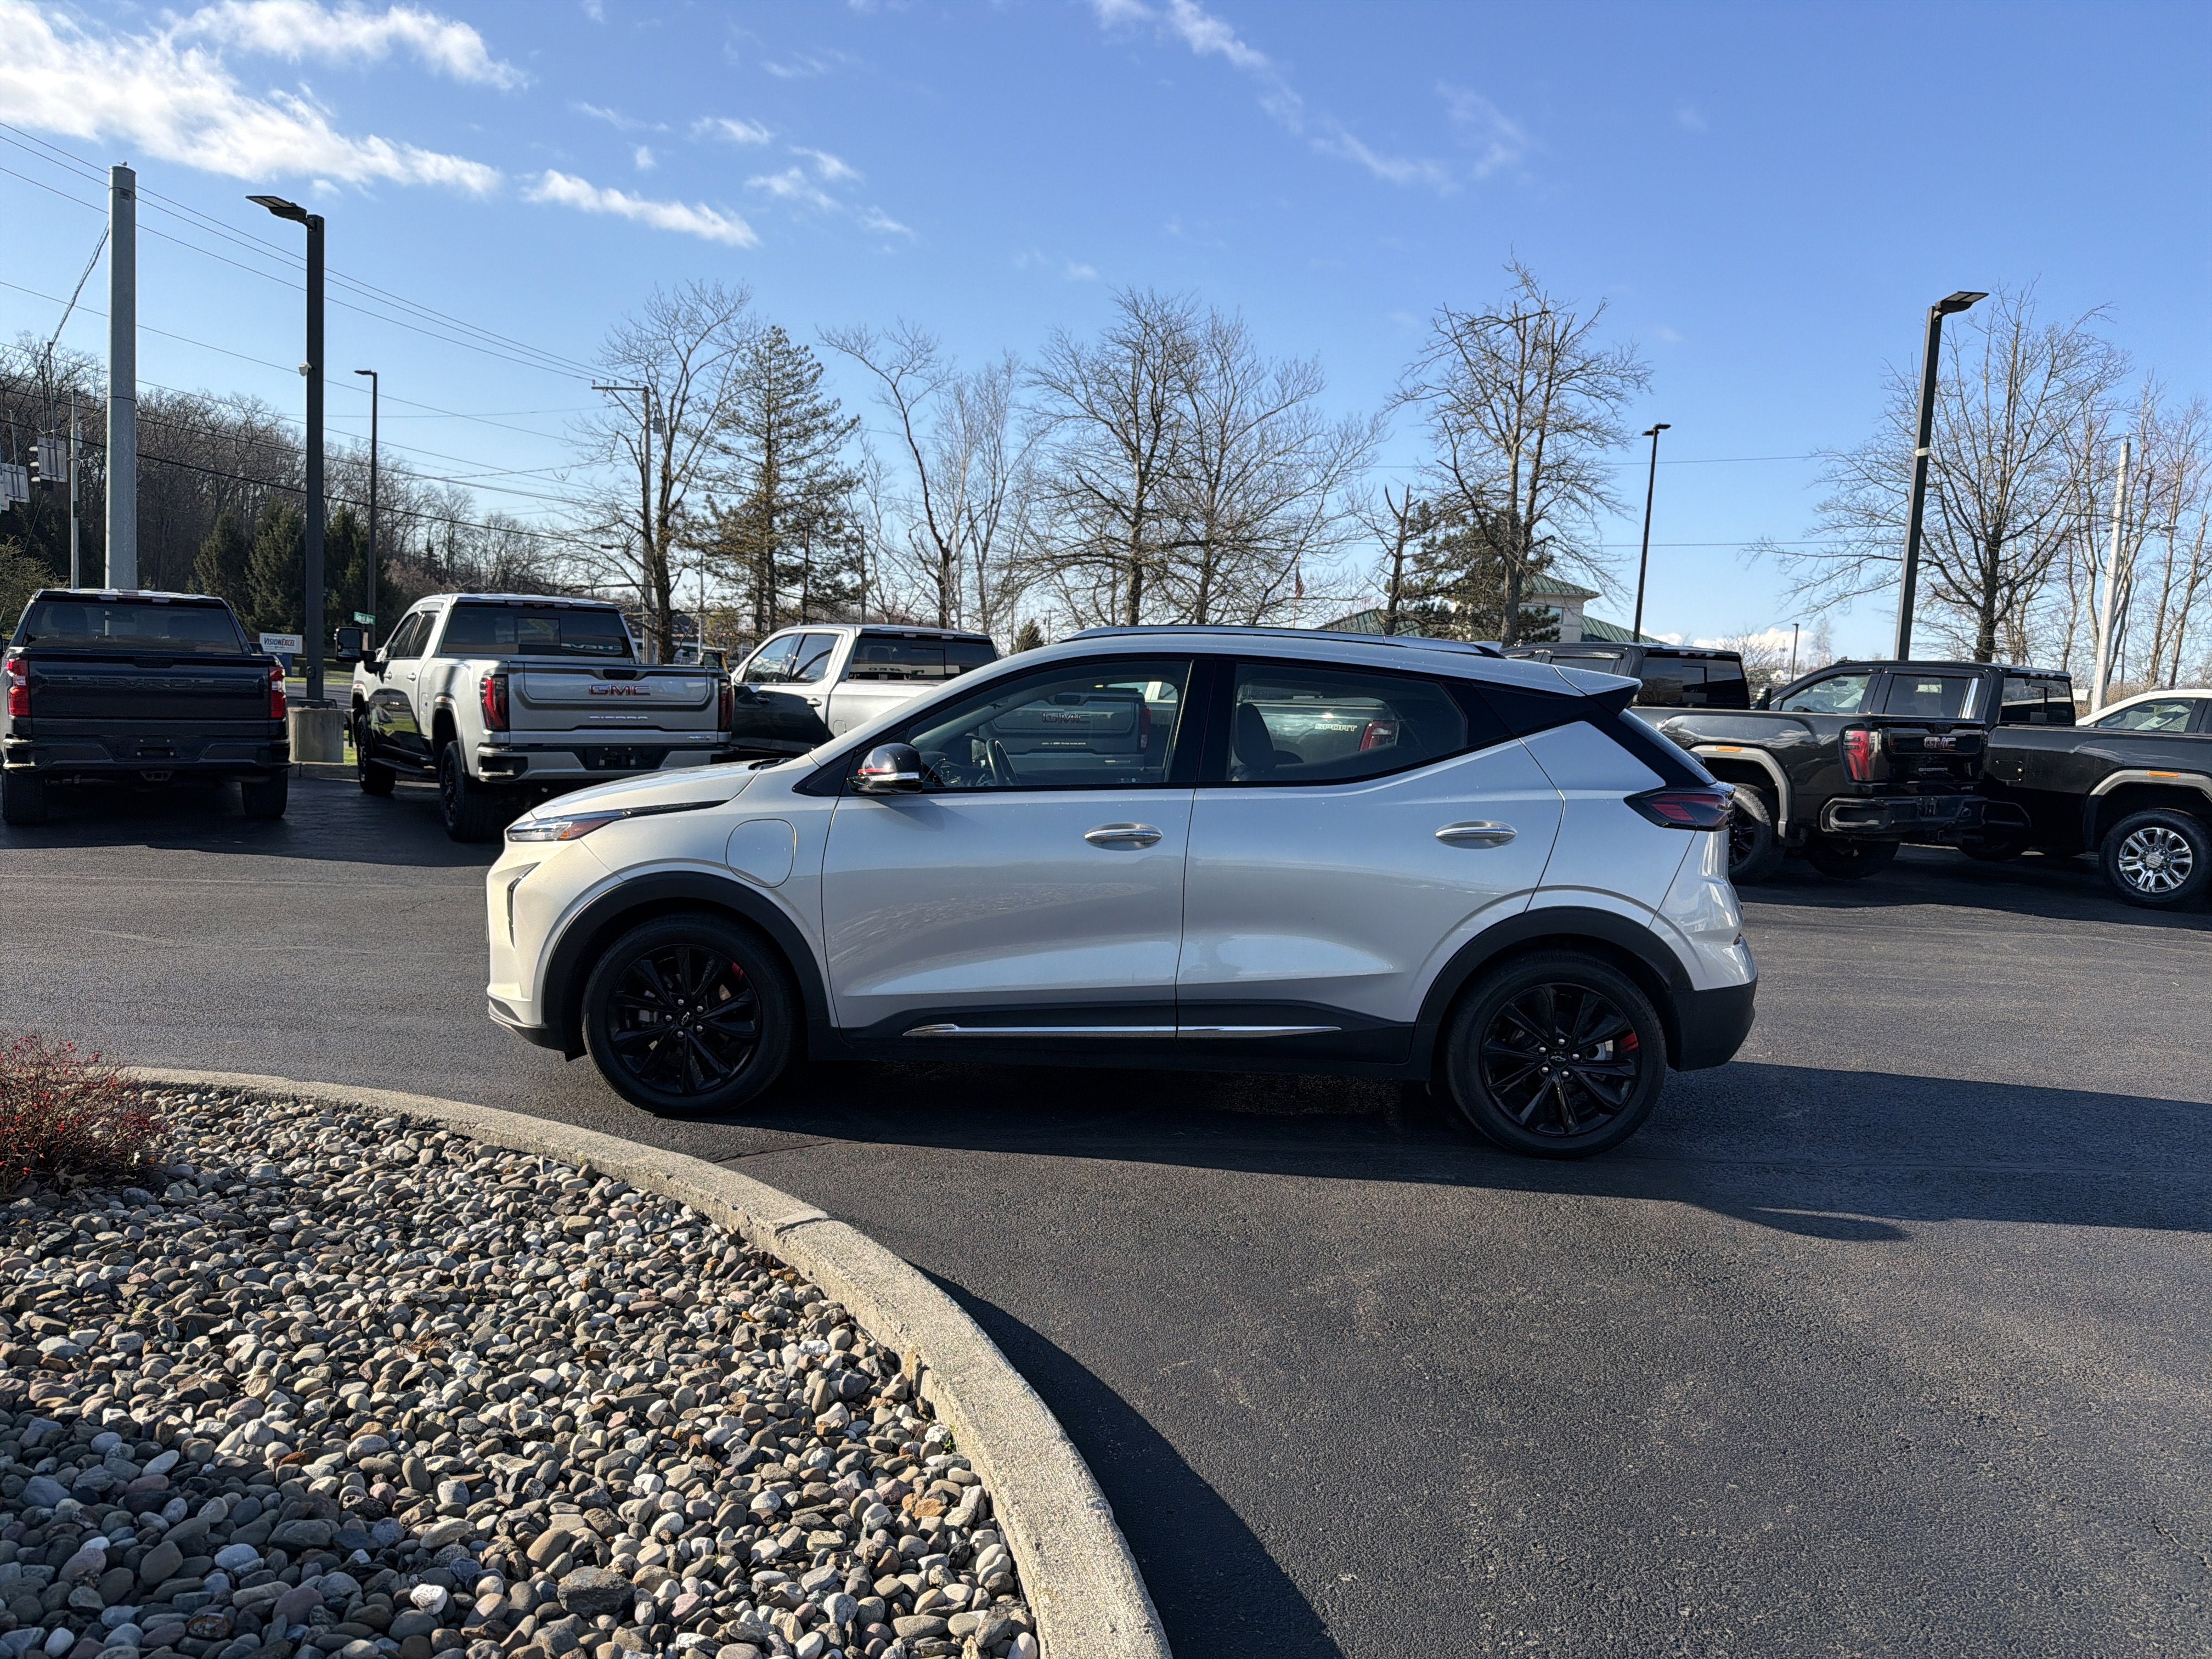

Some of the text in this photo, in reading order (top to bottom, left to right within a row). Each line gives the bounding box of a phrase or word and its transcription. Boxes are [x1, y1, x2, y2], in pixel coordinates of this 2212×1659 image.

[589, 685, 651, 696] GMC
[1042, 712, 1091, 724] GMC
[1314, 723, 1358, 732] SPORT
[1924, 737, 1956, 748] GMC
